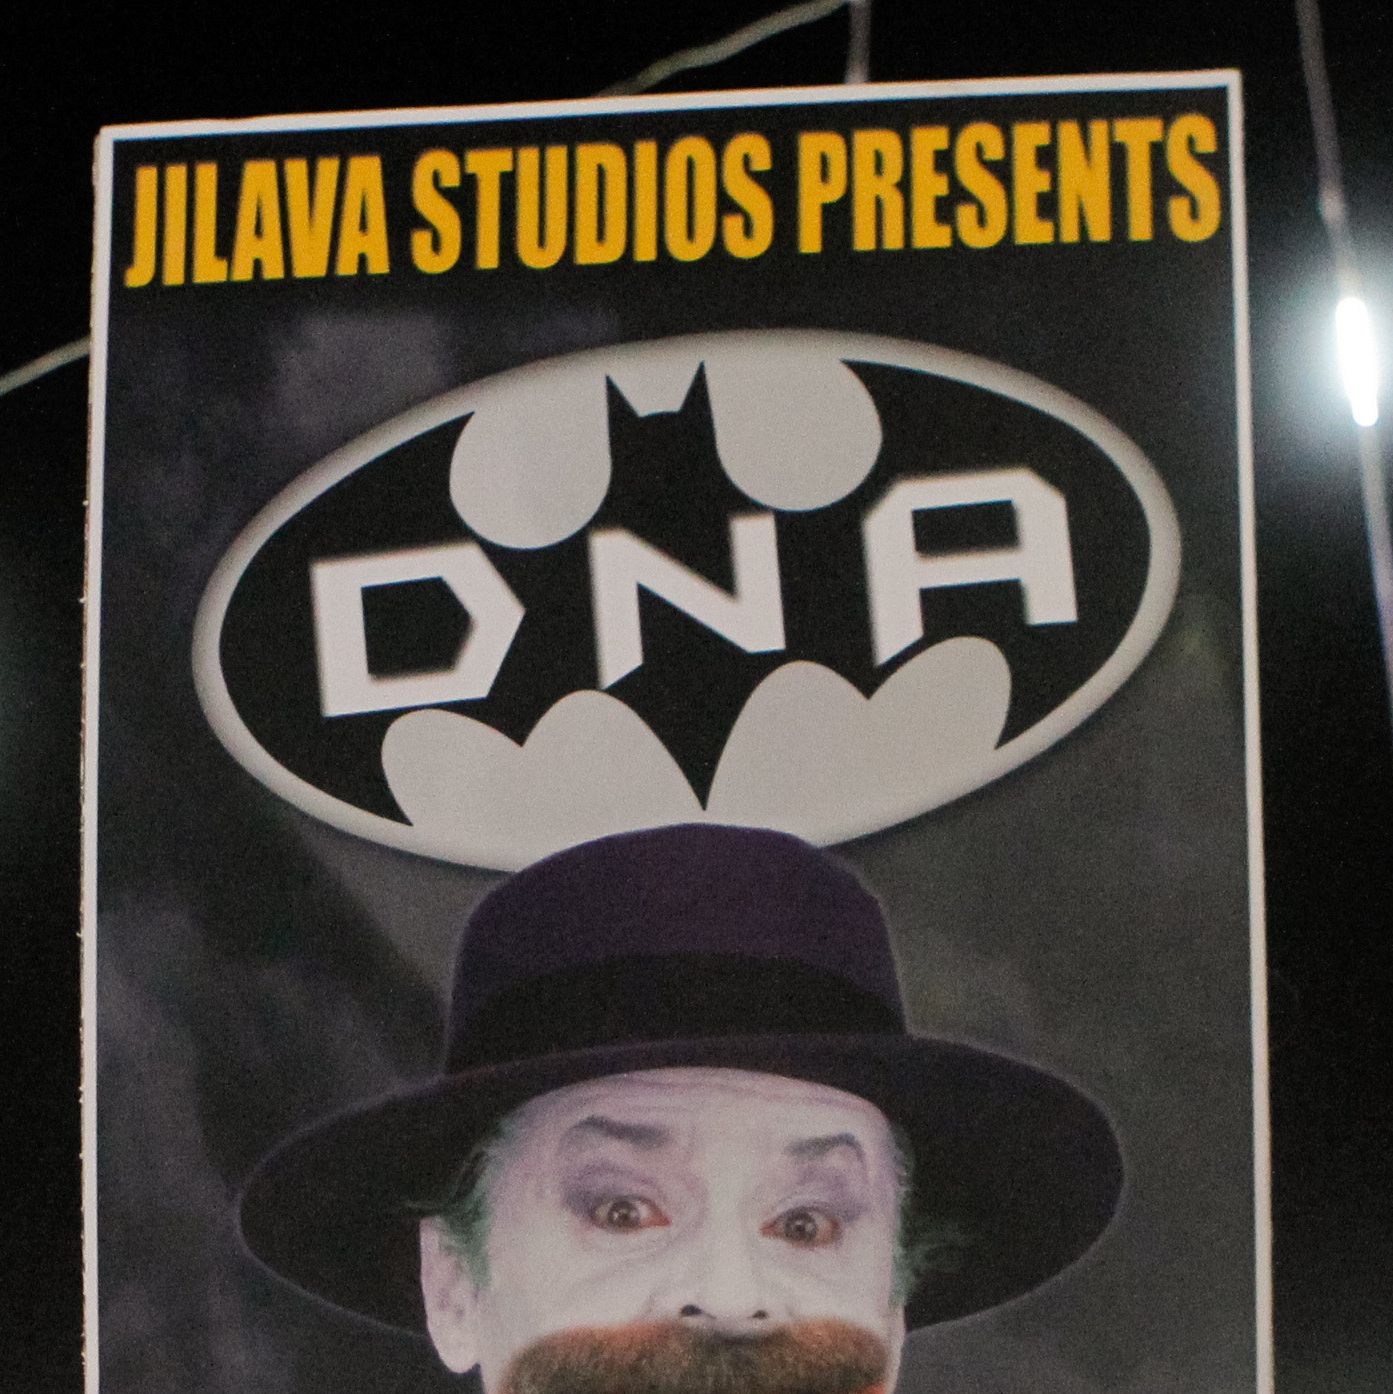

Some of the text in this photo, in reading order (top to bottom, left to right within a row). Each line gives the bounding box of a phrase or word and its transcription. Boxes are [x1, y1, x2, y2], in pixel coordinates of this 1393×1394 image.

[123, 112, 1223, 289] JILAVA STUDIOS PRESENTS
[310, 466, 1079, 719] DNA
